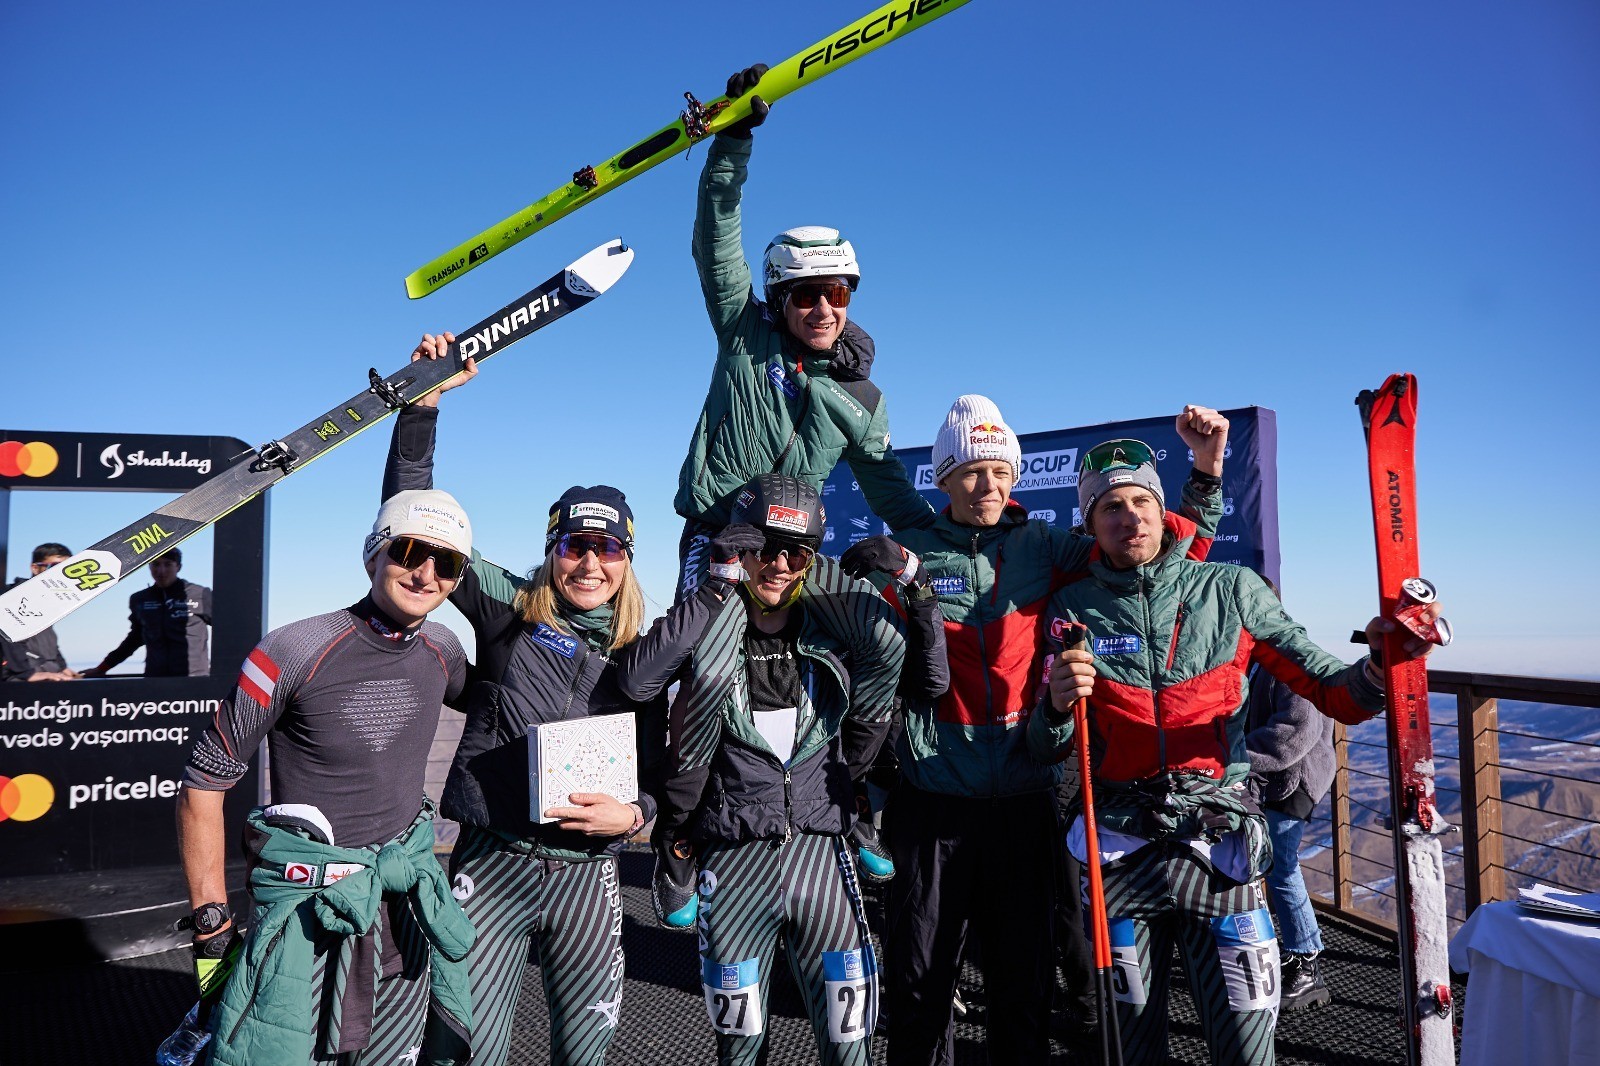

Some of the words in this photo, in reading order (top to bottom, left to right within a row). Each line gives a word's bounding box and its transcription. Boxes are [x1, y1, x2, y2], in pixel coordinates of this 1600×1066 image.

[798, 0, 951, 79] FISCHE
[427, 257, 466, 287] TRANSALP
[475, 245, 487, 260] RC
[459, 287, 560, 361] DYNAFIT
[970, 435, 989, 445] Red
[990, 436, 1007, 446] Bull
[126, 450, 212, 475] Shahdag
[780, 515, 806, 527] Johann
[1386, 469, 1404, 544] ATOMIC
[122, 522, 175, 555] DNA
[62, 558, 115, 591] 64
[713, 566, 739, 577] LEKI
[538, 627, 575, 649] pure
[1098, 636, 1137, 648] pure
[101, 698, 223, 720] həyəcanın
[69, 726, 189, 750] yaşamaq:
[1235, 947, 1275, 1000] 15
[713, 992, 749, 1030] 27
[838, 985, 869, 1034] 27
